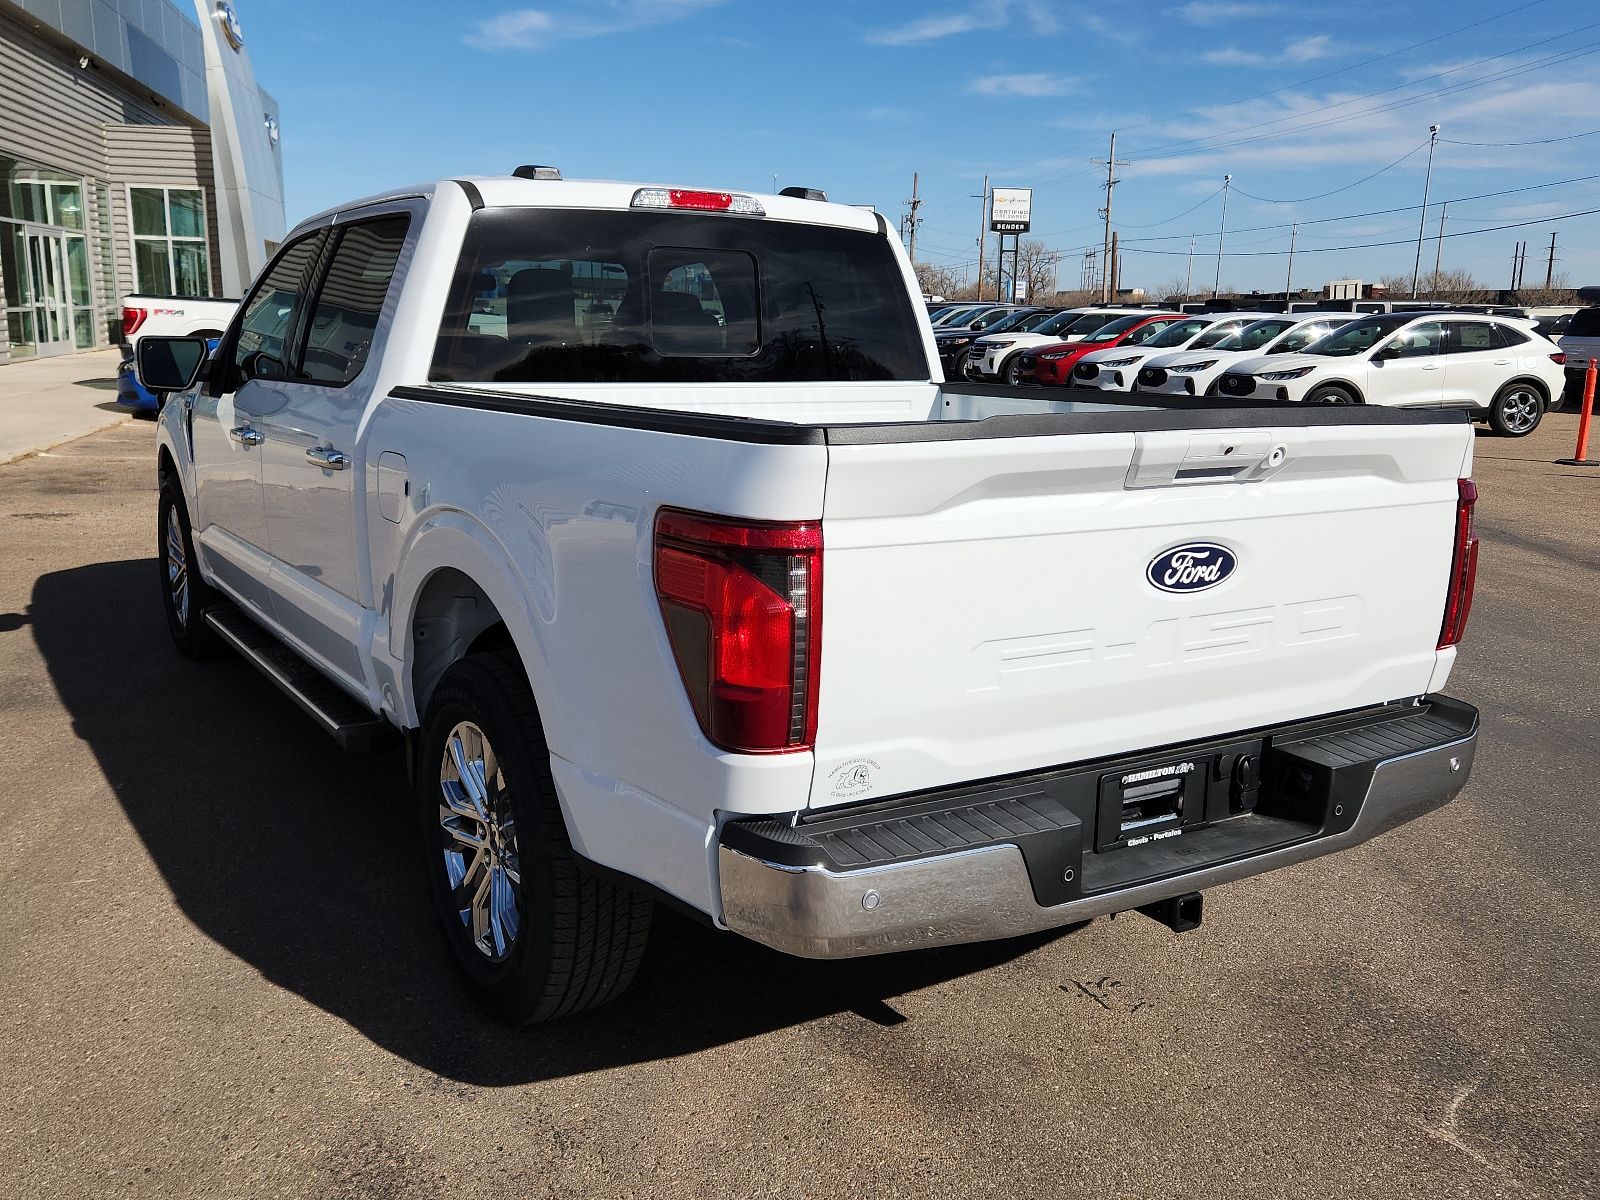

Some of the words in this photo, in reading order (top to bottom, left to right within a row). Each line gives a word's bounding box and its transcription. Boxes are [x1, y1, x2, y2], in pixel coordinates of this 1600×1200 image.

[1164, 550, 1221, 586] Ford
[965, 593, 1366, 694] F-150
[1127, 836, 1149, 847] Clovis
[1153, 829, 1182, 841] Portales
